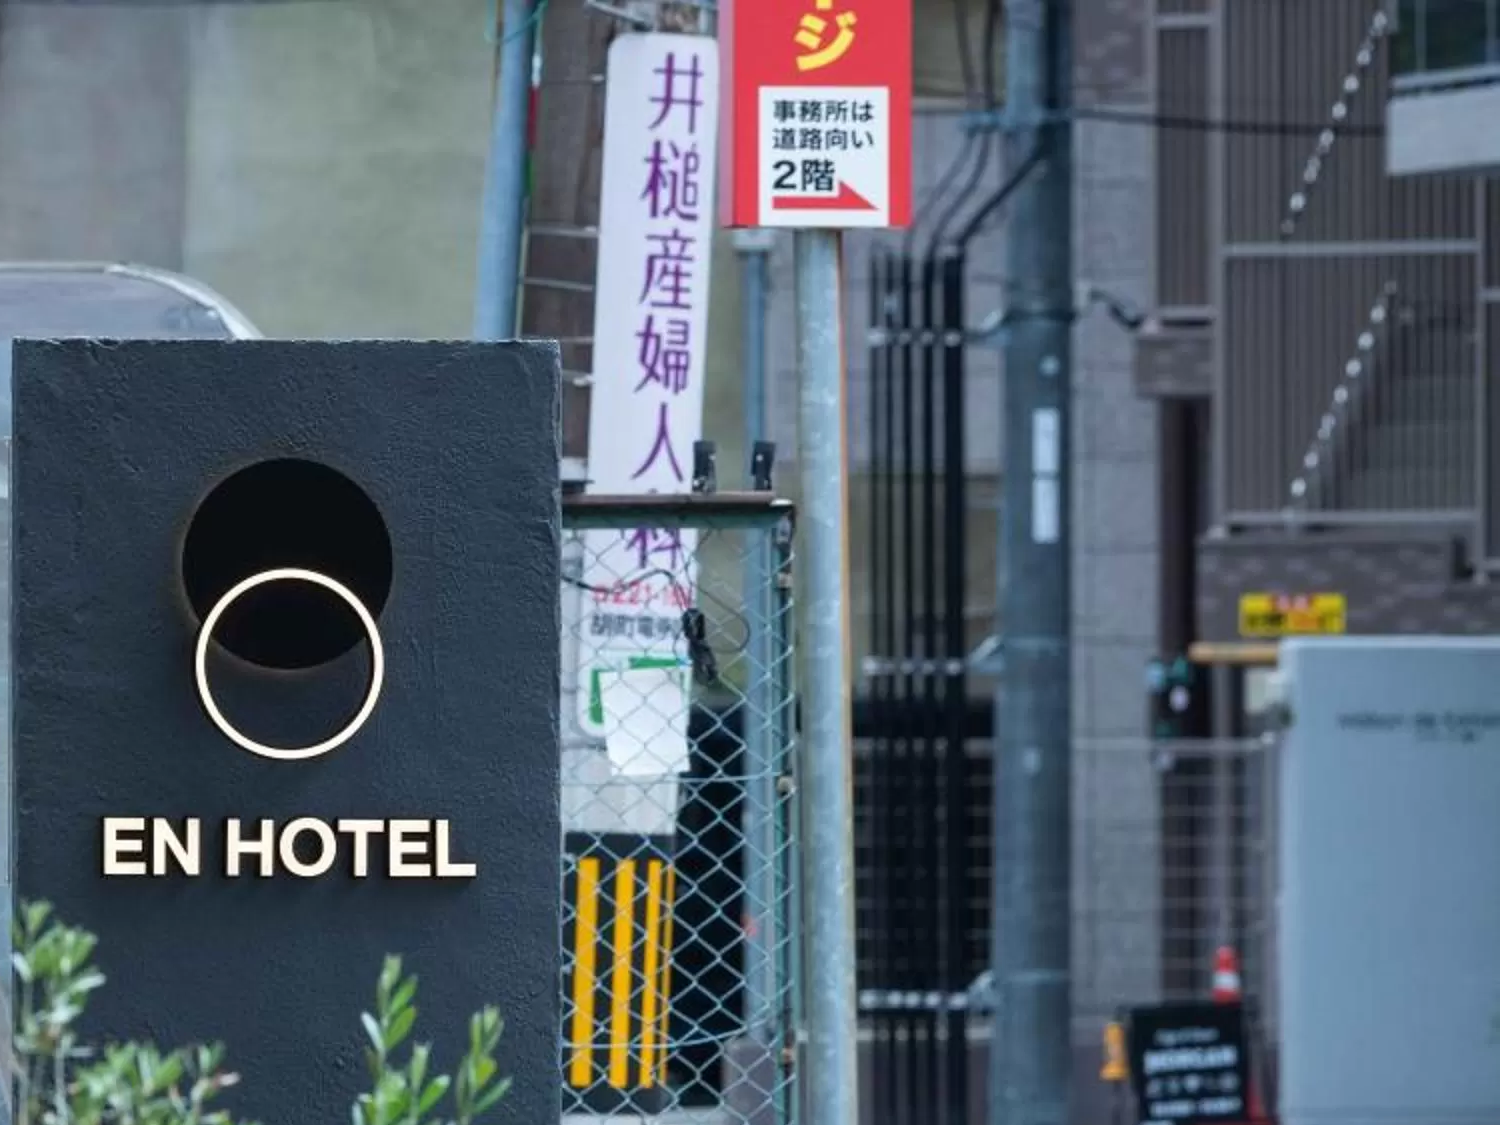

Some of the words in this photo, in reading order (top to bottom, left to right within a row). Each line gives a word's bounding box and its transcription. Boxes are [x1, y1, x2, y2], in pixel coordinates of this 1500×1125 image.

[794, 0, 858, 72] ジ
[773, 100, 874, 123] 事務所は
[772, 129, 874, 151] 道路向い
[772, 159, 836, 193] 2階
[103, 817, 200, 875] EN
[227, 817, 477, 877] HOTEL
